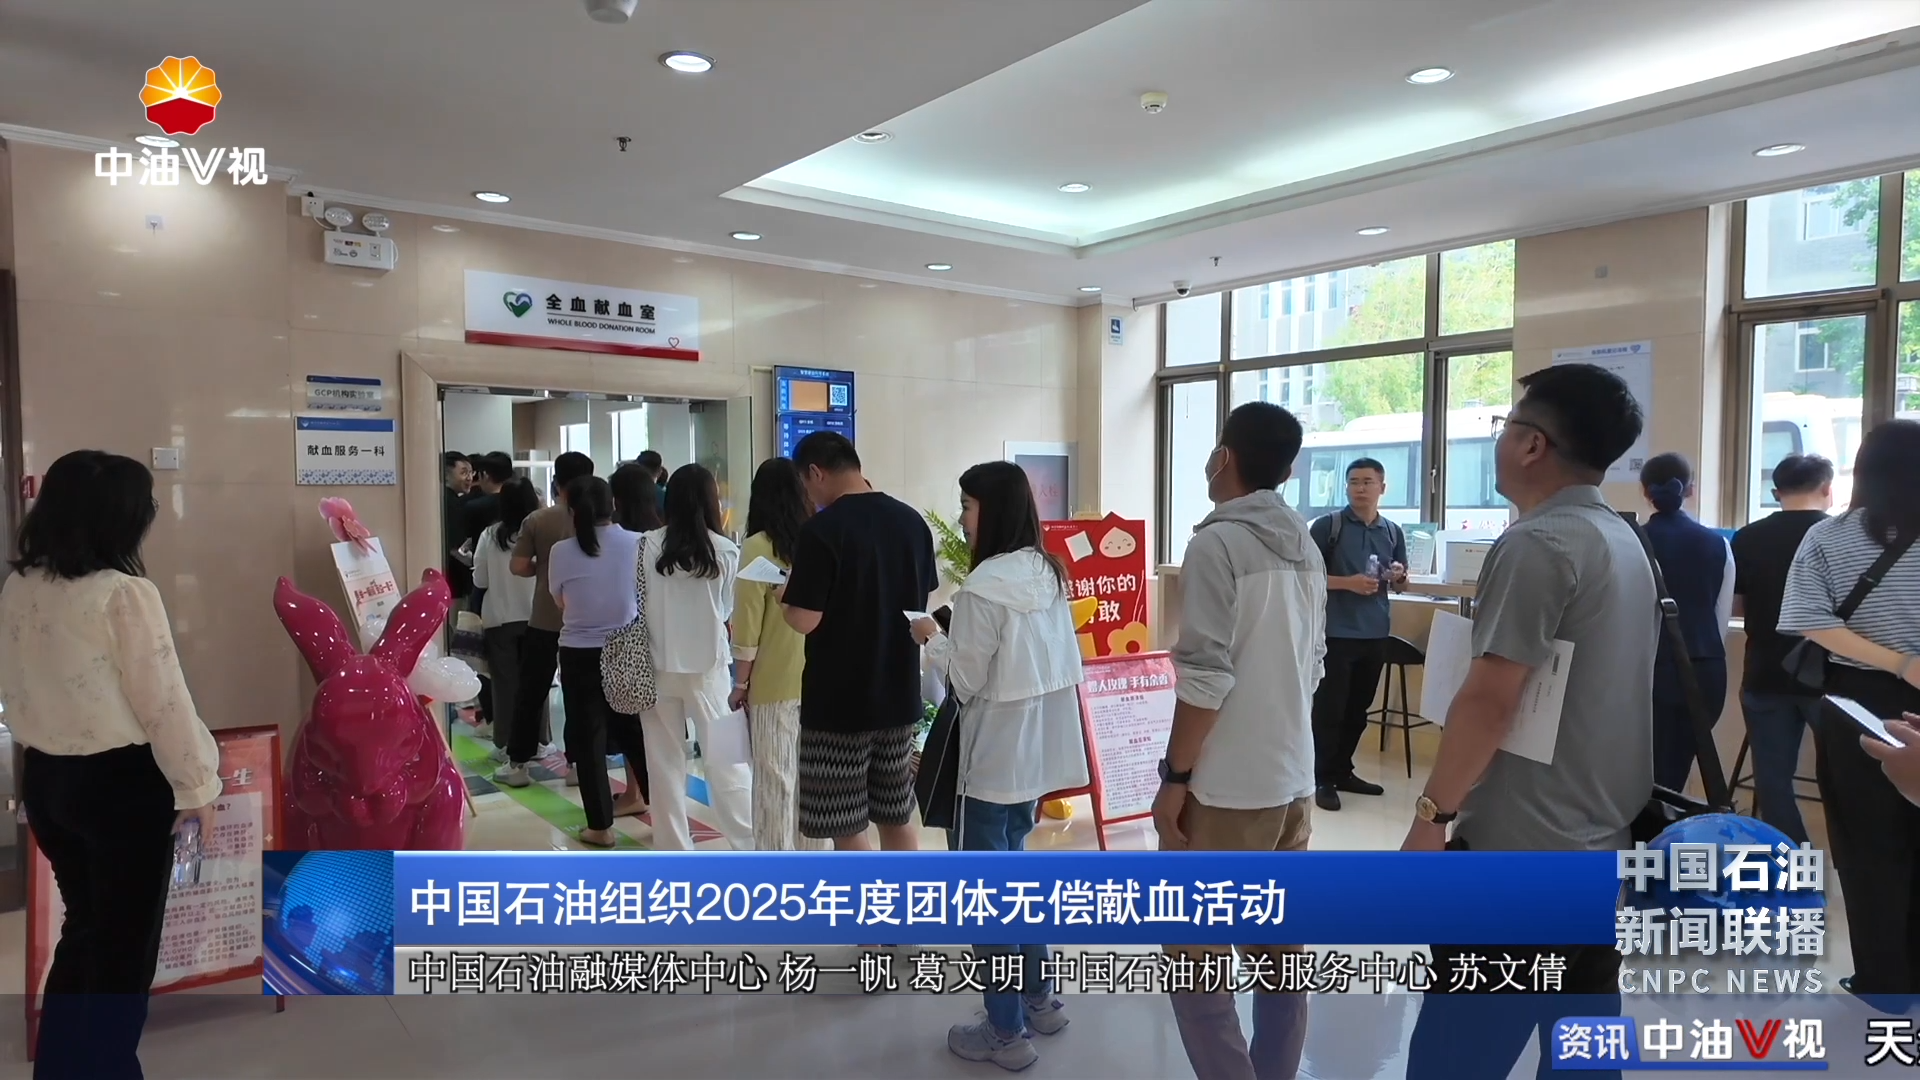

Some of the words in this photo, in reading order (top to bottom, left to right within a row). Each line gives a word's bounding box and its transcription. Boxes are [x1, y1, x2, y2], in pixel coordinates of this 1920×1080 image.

[546, 293, 656, 321] 全血献血室
[547, 318, 573, 327] WHOLE
[574, 320, 598, 329] BLOOD
[599, 323, 634, 333] DONATION
[635, 326, 656, 335] ROOM
[307, 445, 385, 457] 献血服务一科
[1129, 673, 1169, 690] 手有余香
